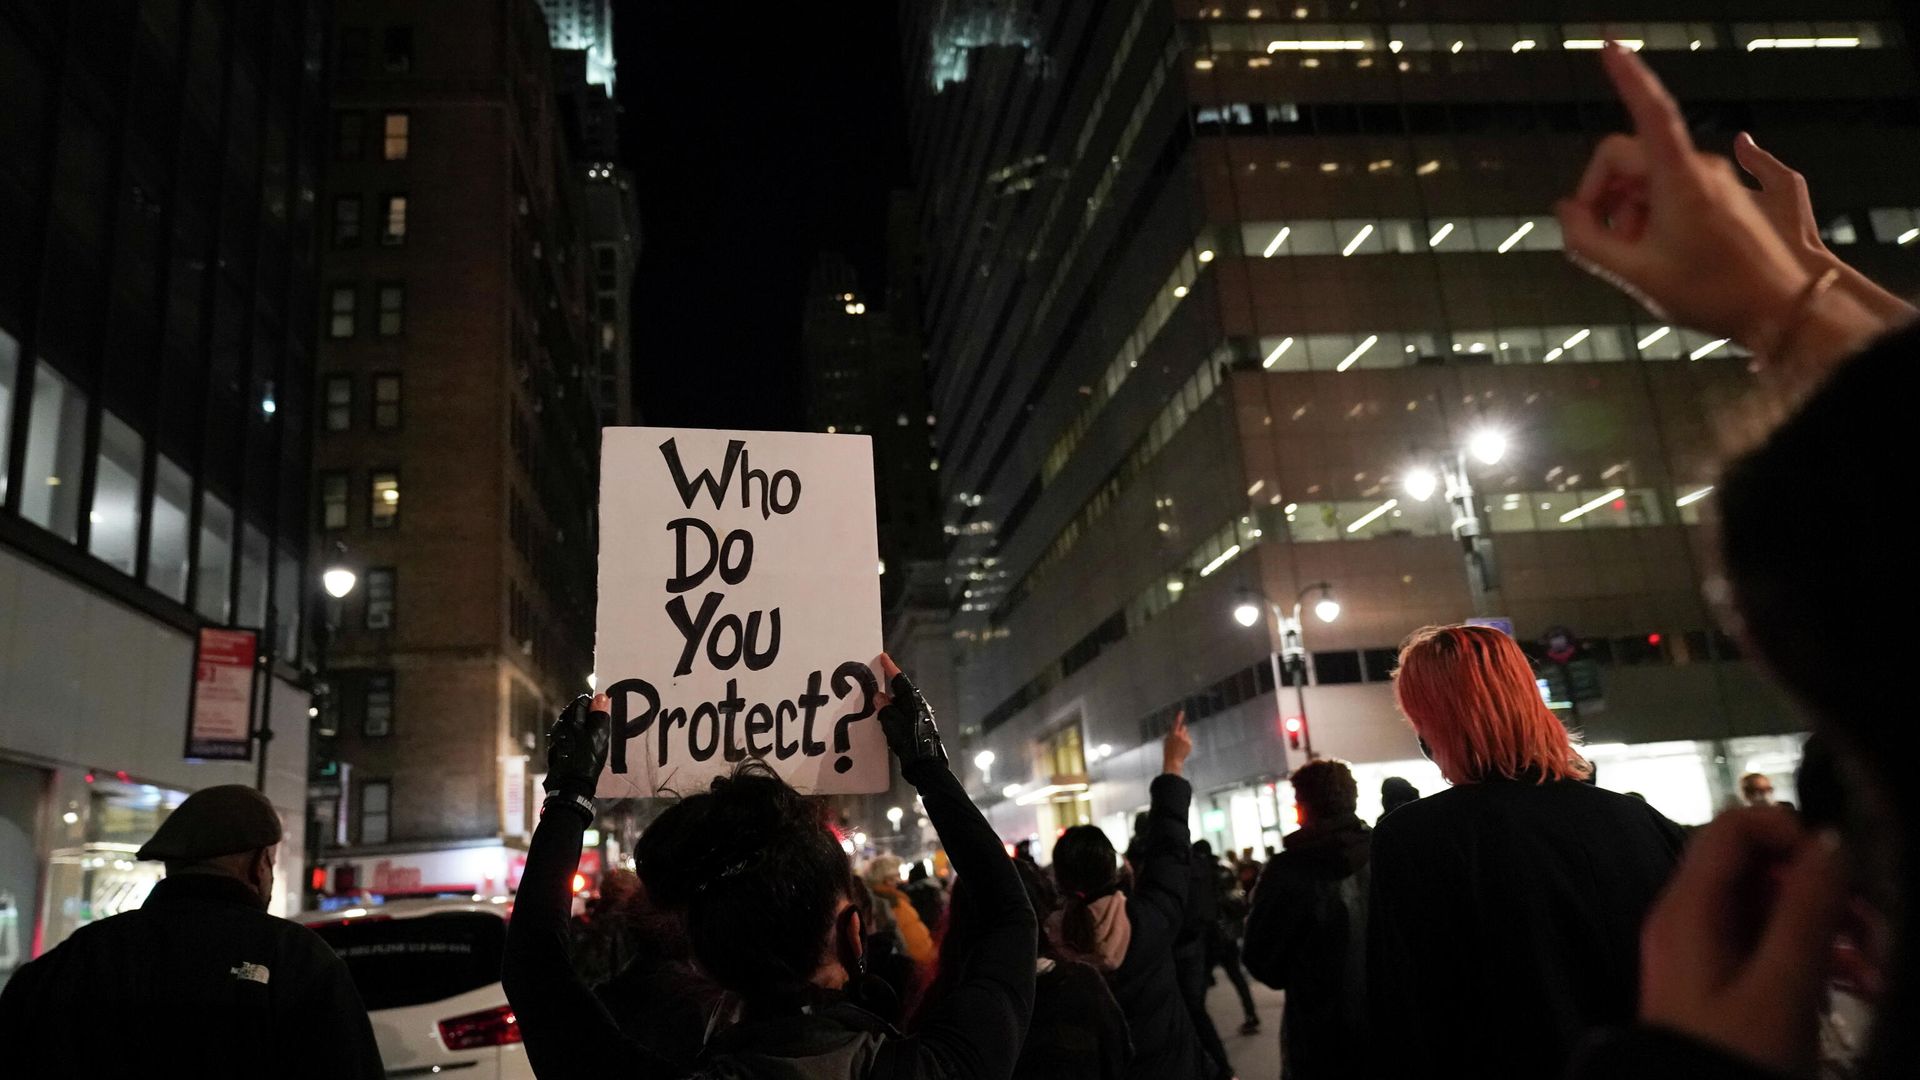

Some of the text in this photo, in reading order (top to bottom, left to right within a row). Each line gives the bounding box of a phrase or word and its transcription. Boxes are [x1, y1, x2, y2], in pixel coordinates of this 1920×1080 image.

[659, 437, 802, 520] Who
[666, 517, 754, 594] Do
[665, 591, 781, 677] You
[606, 661, 879, 774] Protect?
